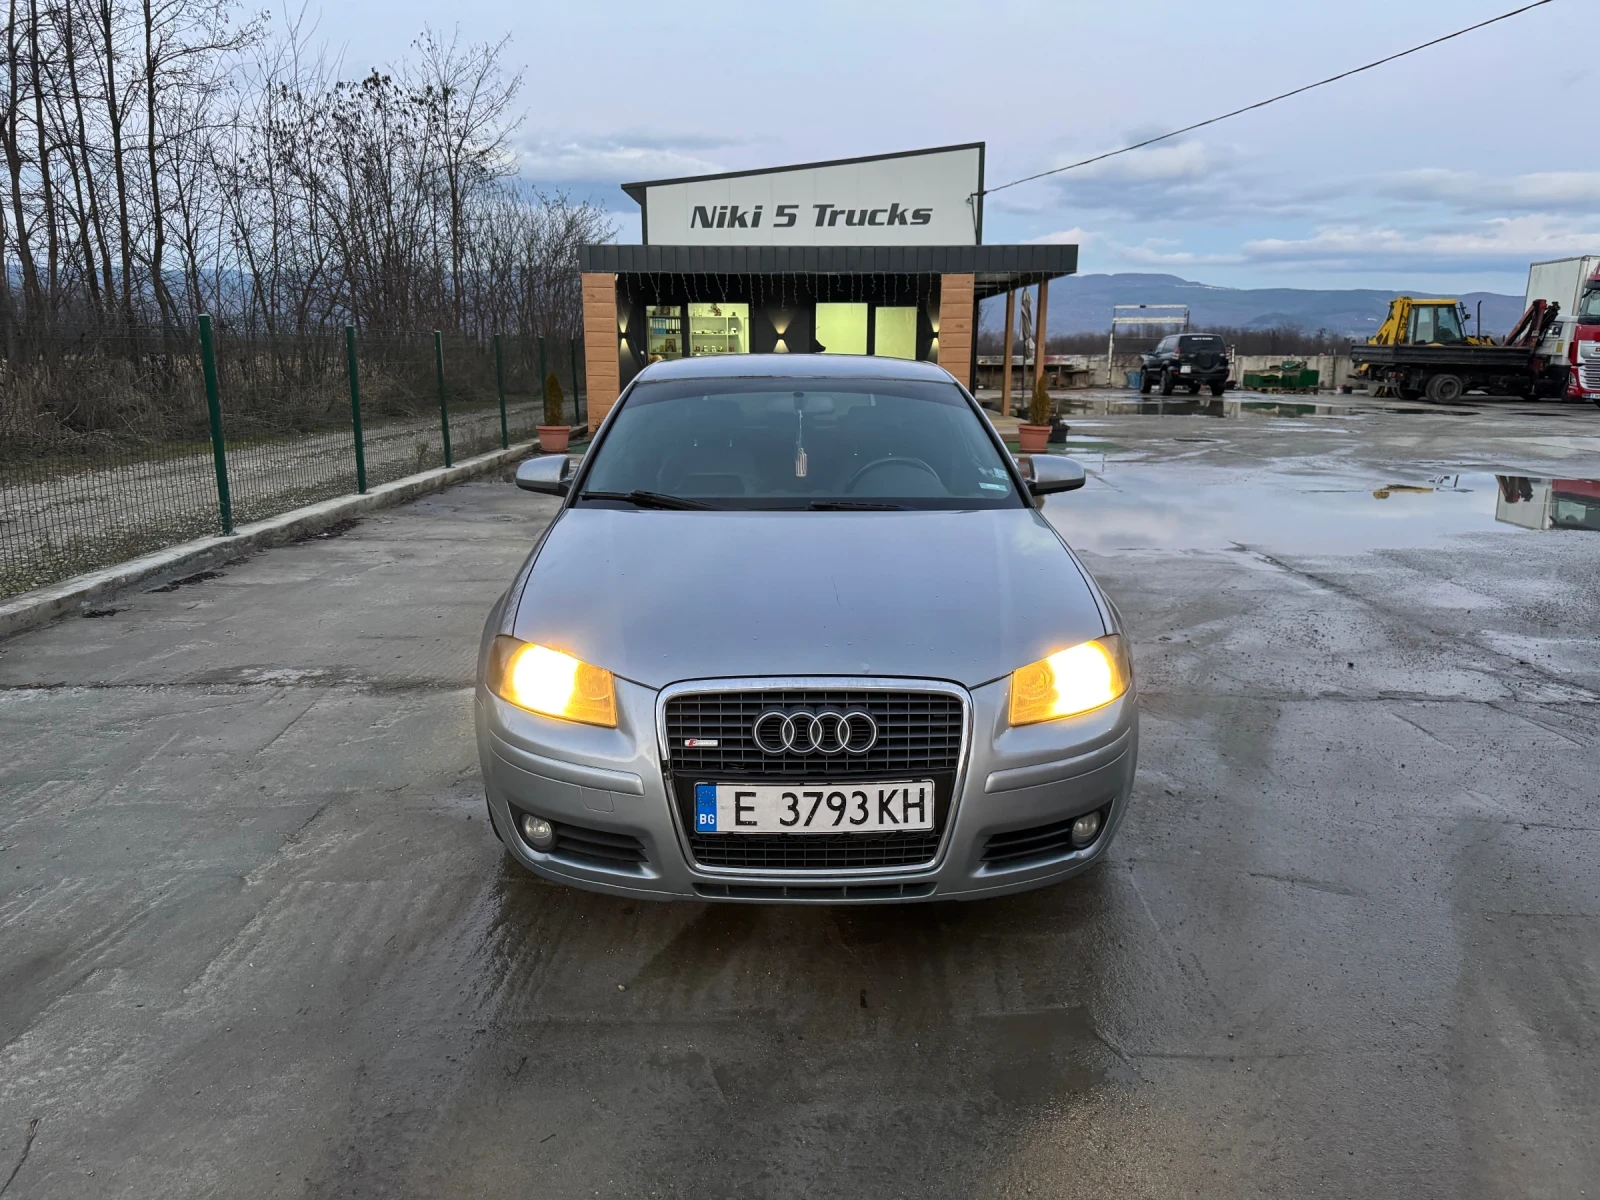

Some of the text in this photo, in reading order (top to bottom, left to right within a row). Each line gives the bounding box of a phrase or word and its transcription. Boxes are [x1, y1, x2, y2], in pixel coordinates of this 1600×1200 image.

[690, 203, 934, 229] Niki 5 Trucks
[699, 813, 715, 825] BG
[734, 791, 758, 827] E
